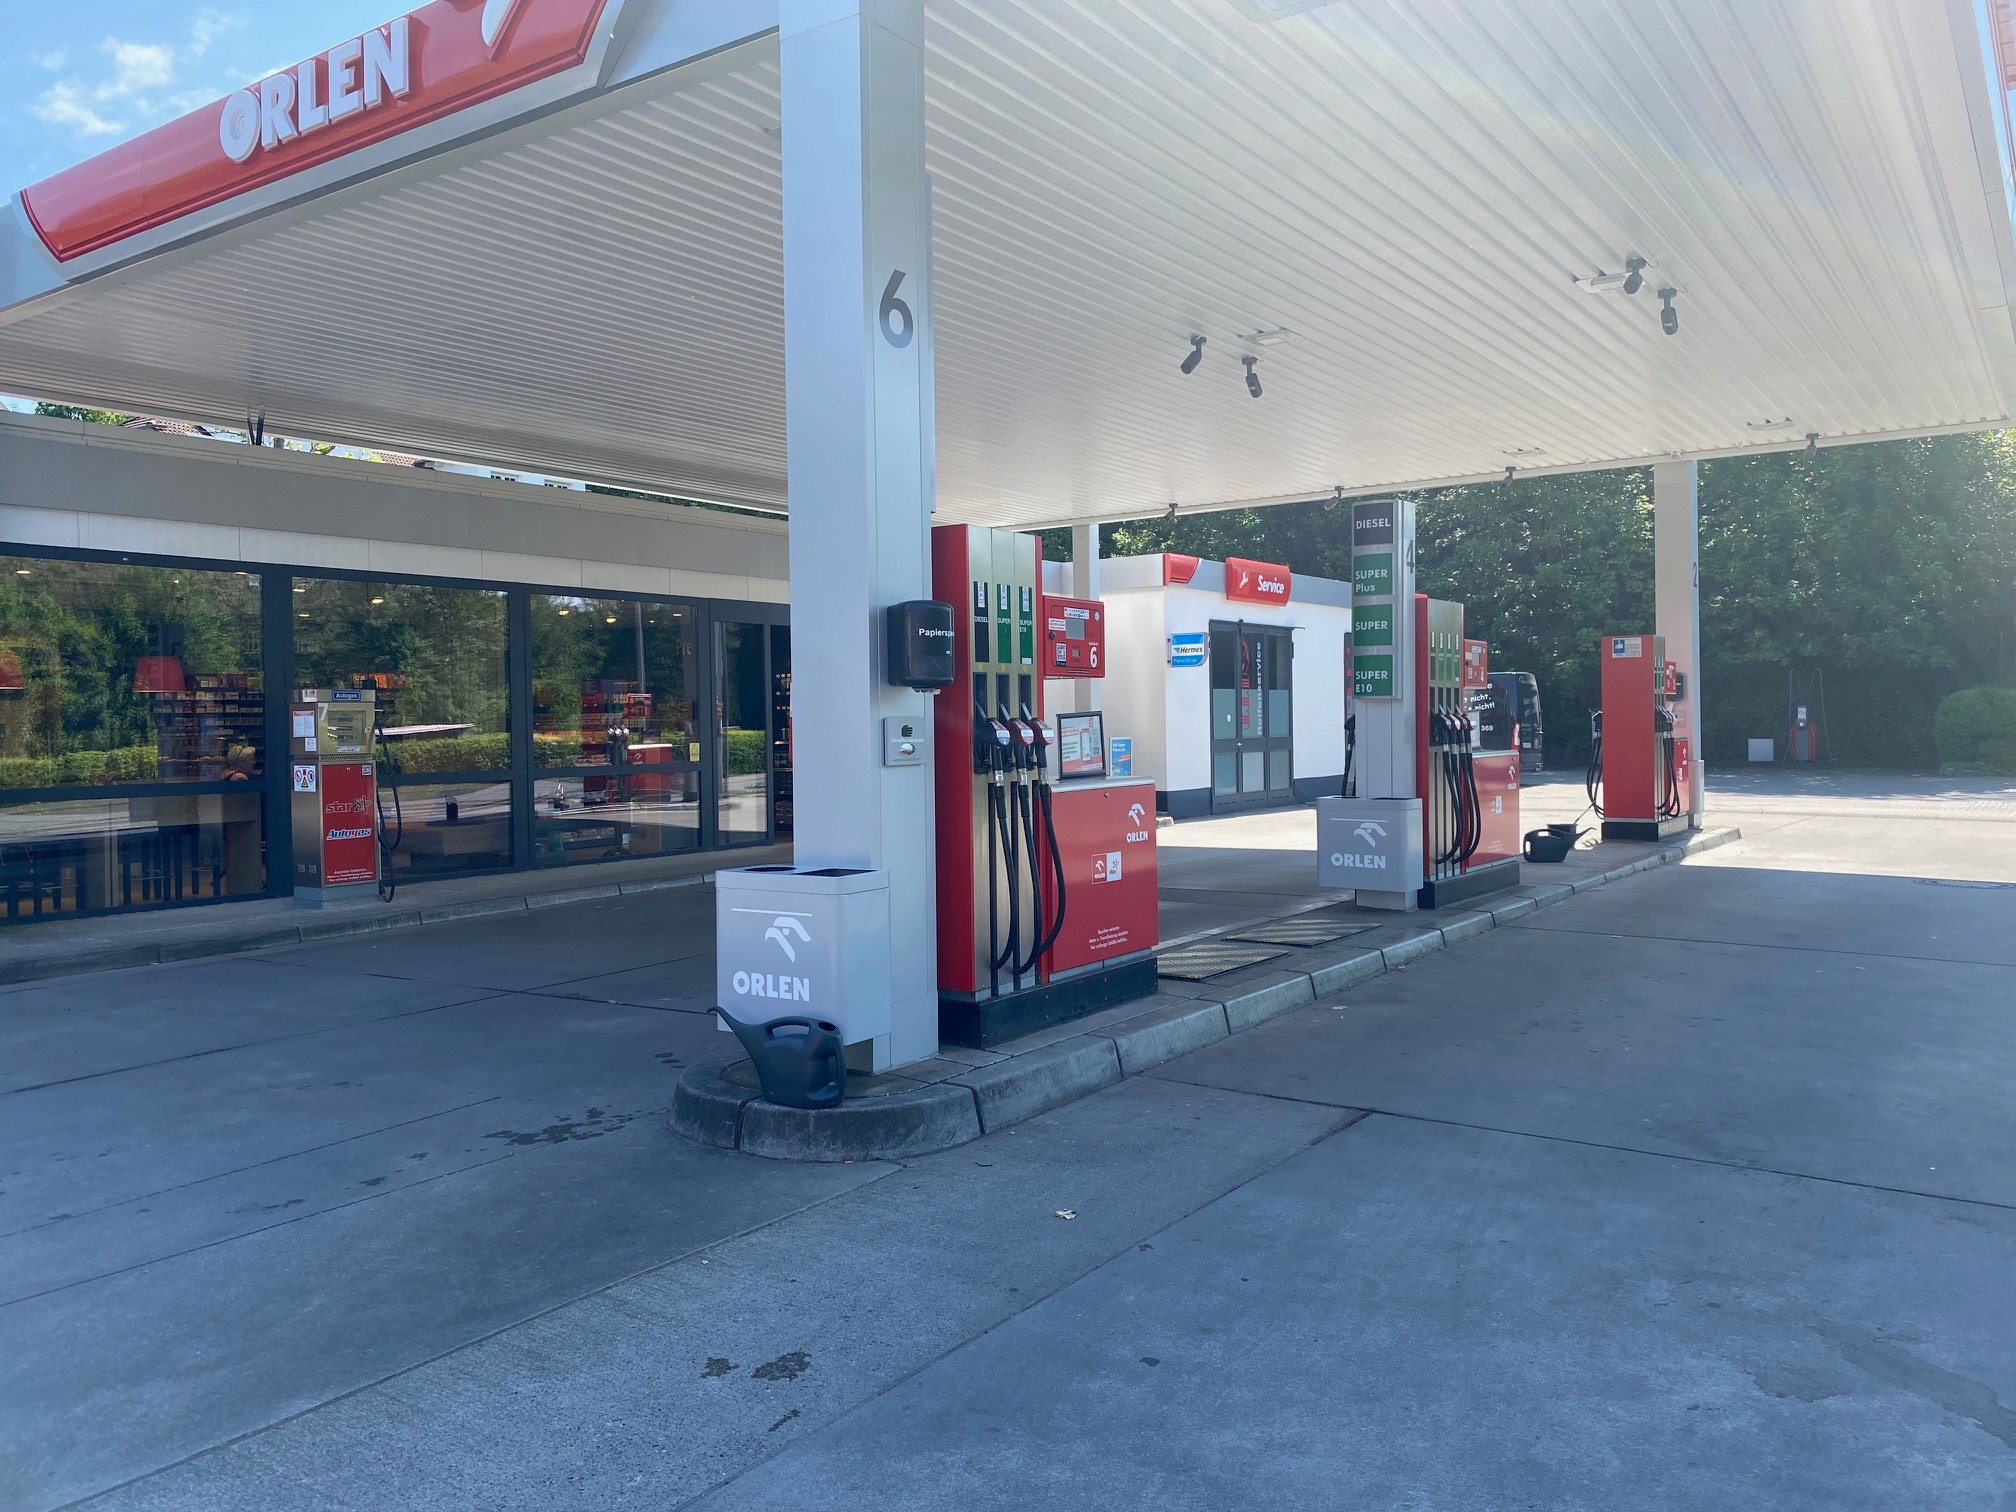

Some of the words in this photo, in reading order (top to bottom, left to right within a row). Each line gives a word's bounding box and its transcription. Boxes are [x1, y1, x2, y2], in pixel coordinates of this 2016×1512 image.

[219, 16, 410, 164] ORLEN
[879, 269, 914, 349] 6
[1356, 518, 1391, 530] DIESEL
[1406, 539, 1415, 574] 4
[1355, 569, 1388, 580] SUPER
[1257, 575, 1285, 595] Service
[1355, 584, 1376, 593] Plus
[974, 615, 988, 623] DIESEL
[997, 617, 1011, 625] SUPER
[1019, 619, 1032, 627] SUPER
[1355, 620, 1388, 631] SUPER
[1180, 646, 1203, 654] Hermes
[1090, 646, 1098, 668] 6
[1355, 670, 1388, 681] SUPER
[1355, 683, 1373, 694] E10
[335, 692, 358, 700] Autogas
[318, 702, 328, 722] 7
[325, 800, 353, 814] star
[326, 827, 372, 840] Autogas
[1126, 830, 1149, 843] ORLEN
[1330, 852, 1386, 870] ORLEN
[732, 970, 810, 1002] ORLEN
